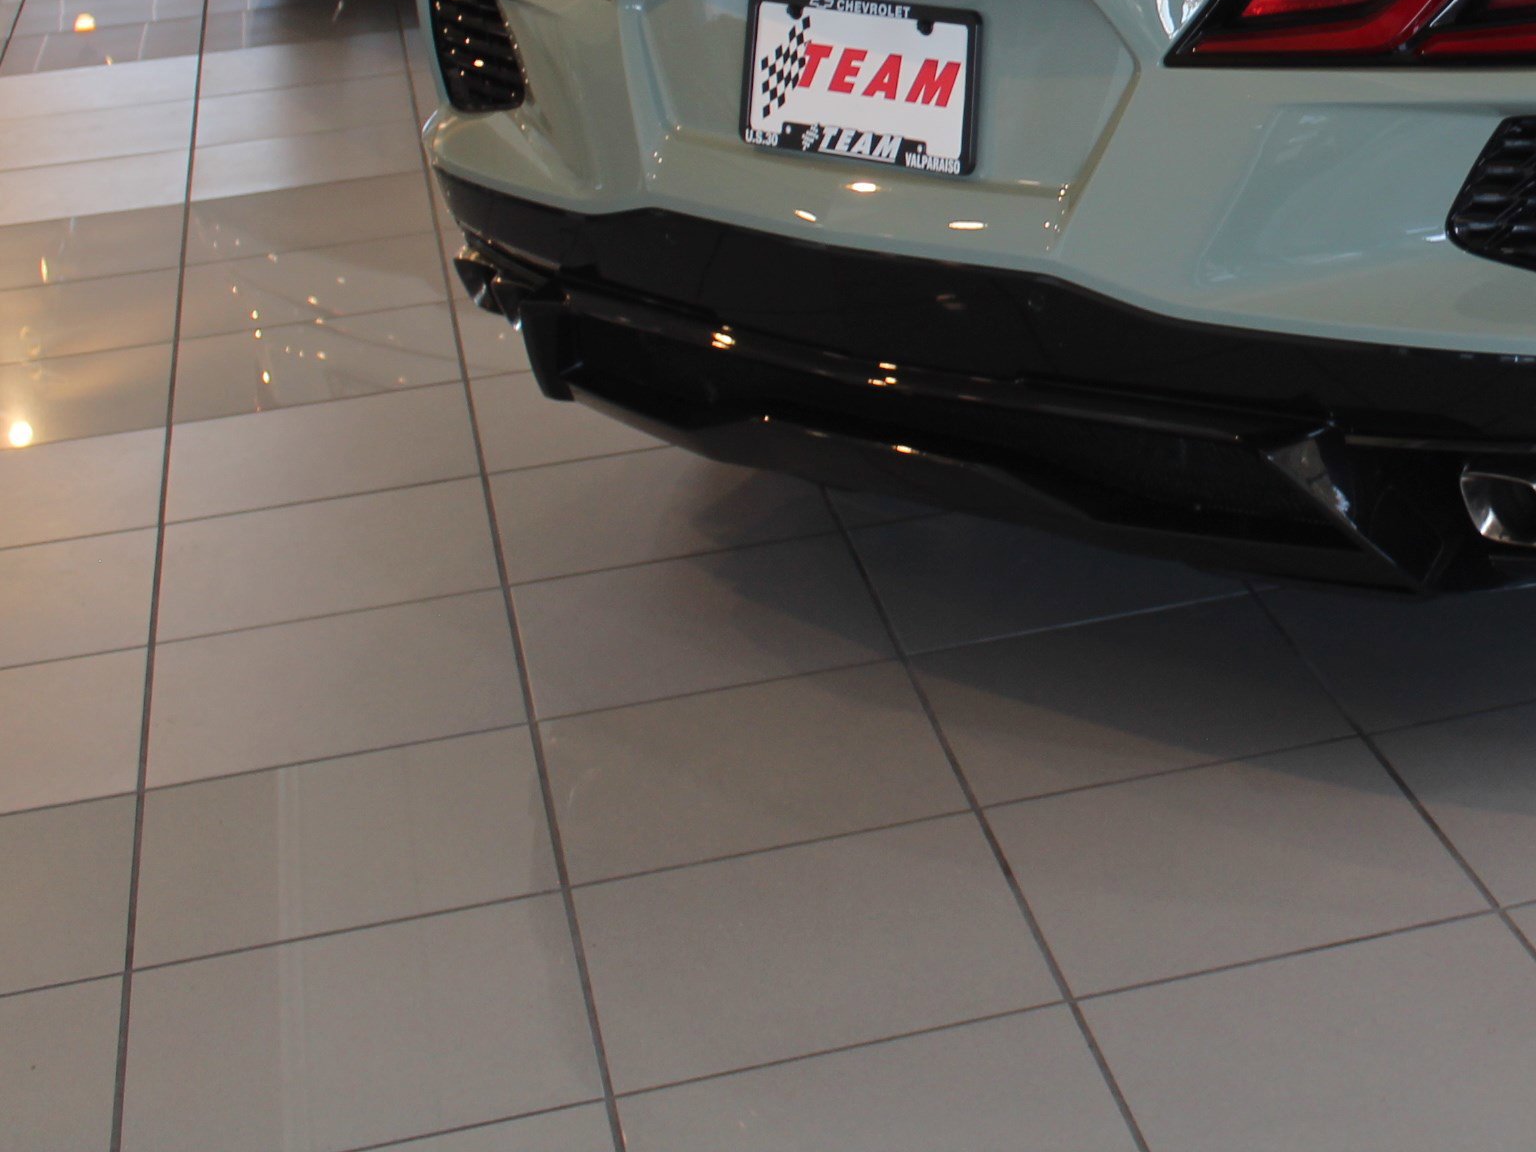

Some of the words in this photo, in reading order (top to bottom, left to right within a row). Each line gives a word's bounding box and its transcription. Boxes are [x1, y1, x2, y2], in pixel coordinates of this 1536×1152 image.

[836, 0, 912, 18] CHEVROLET
[798, 42, 961, 108] TEAM
[819, 126, 902, 159] TEAM
[905, 152, 961, 175] VALPARAISO
